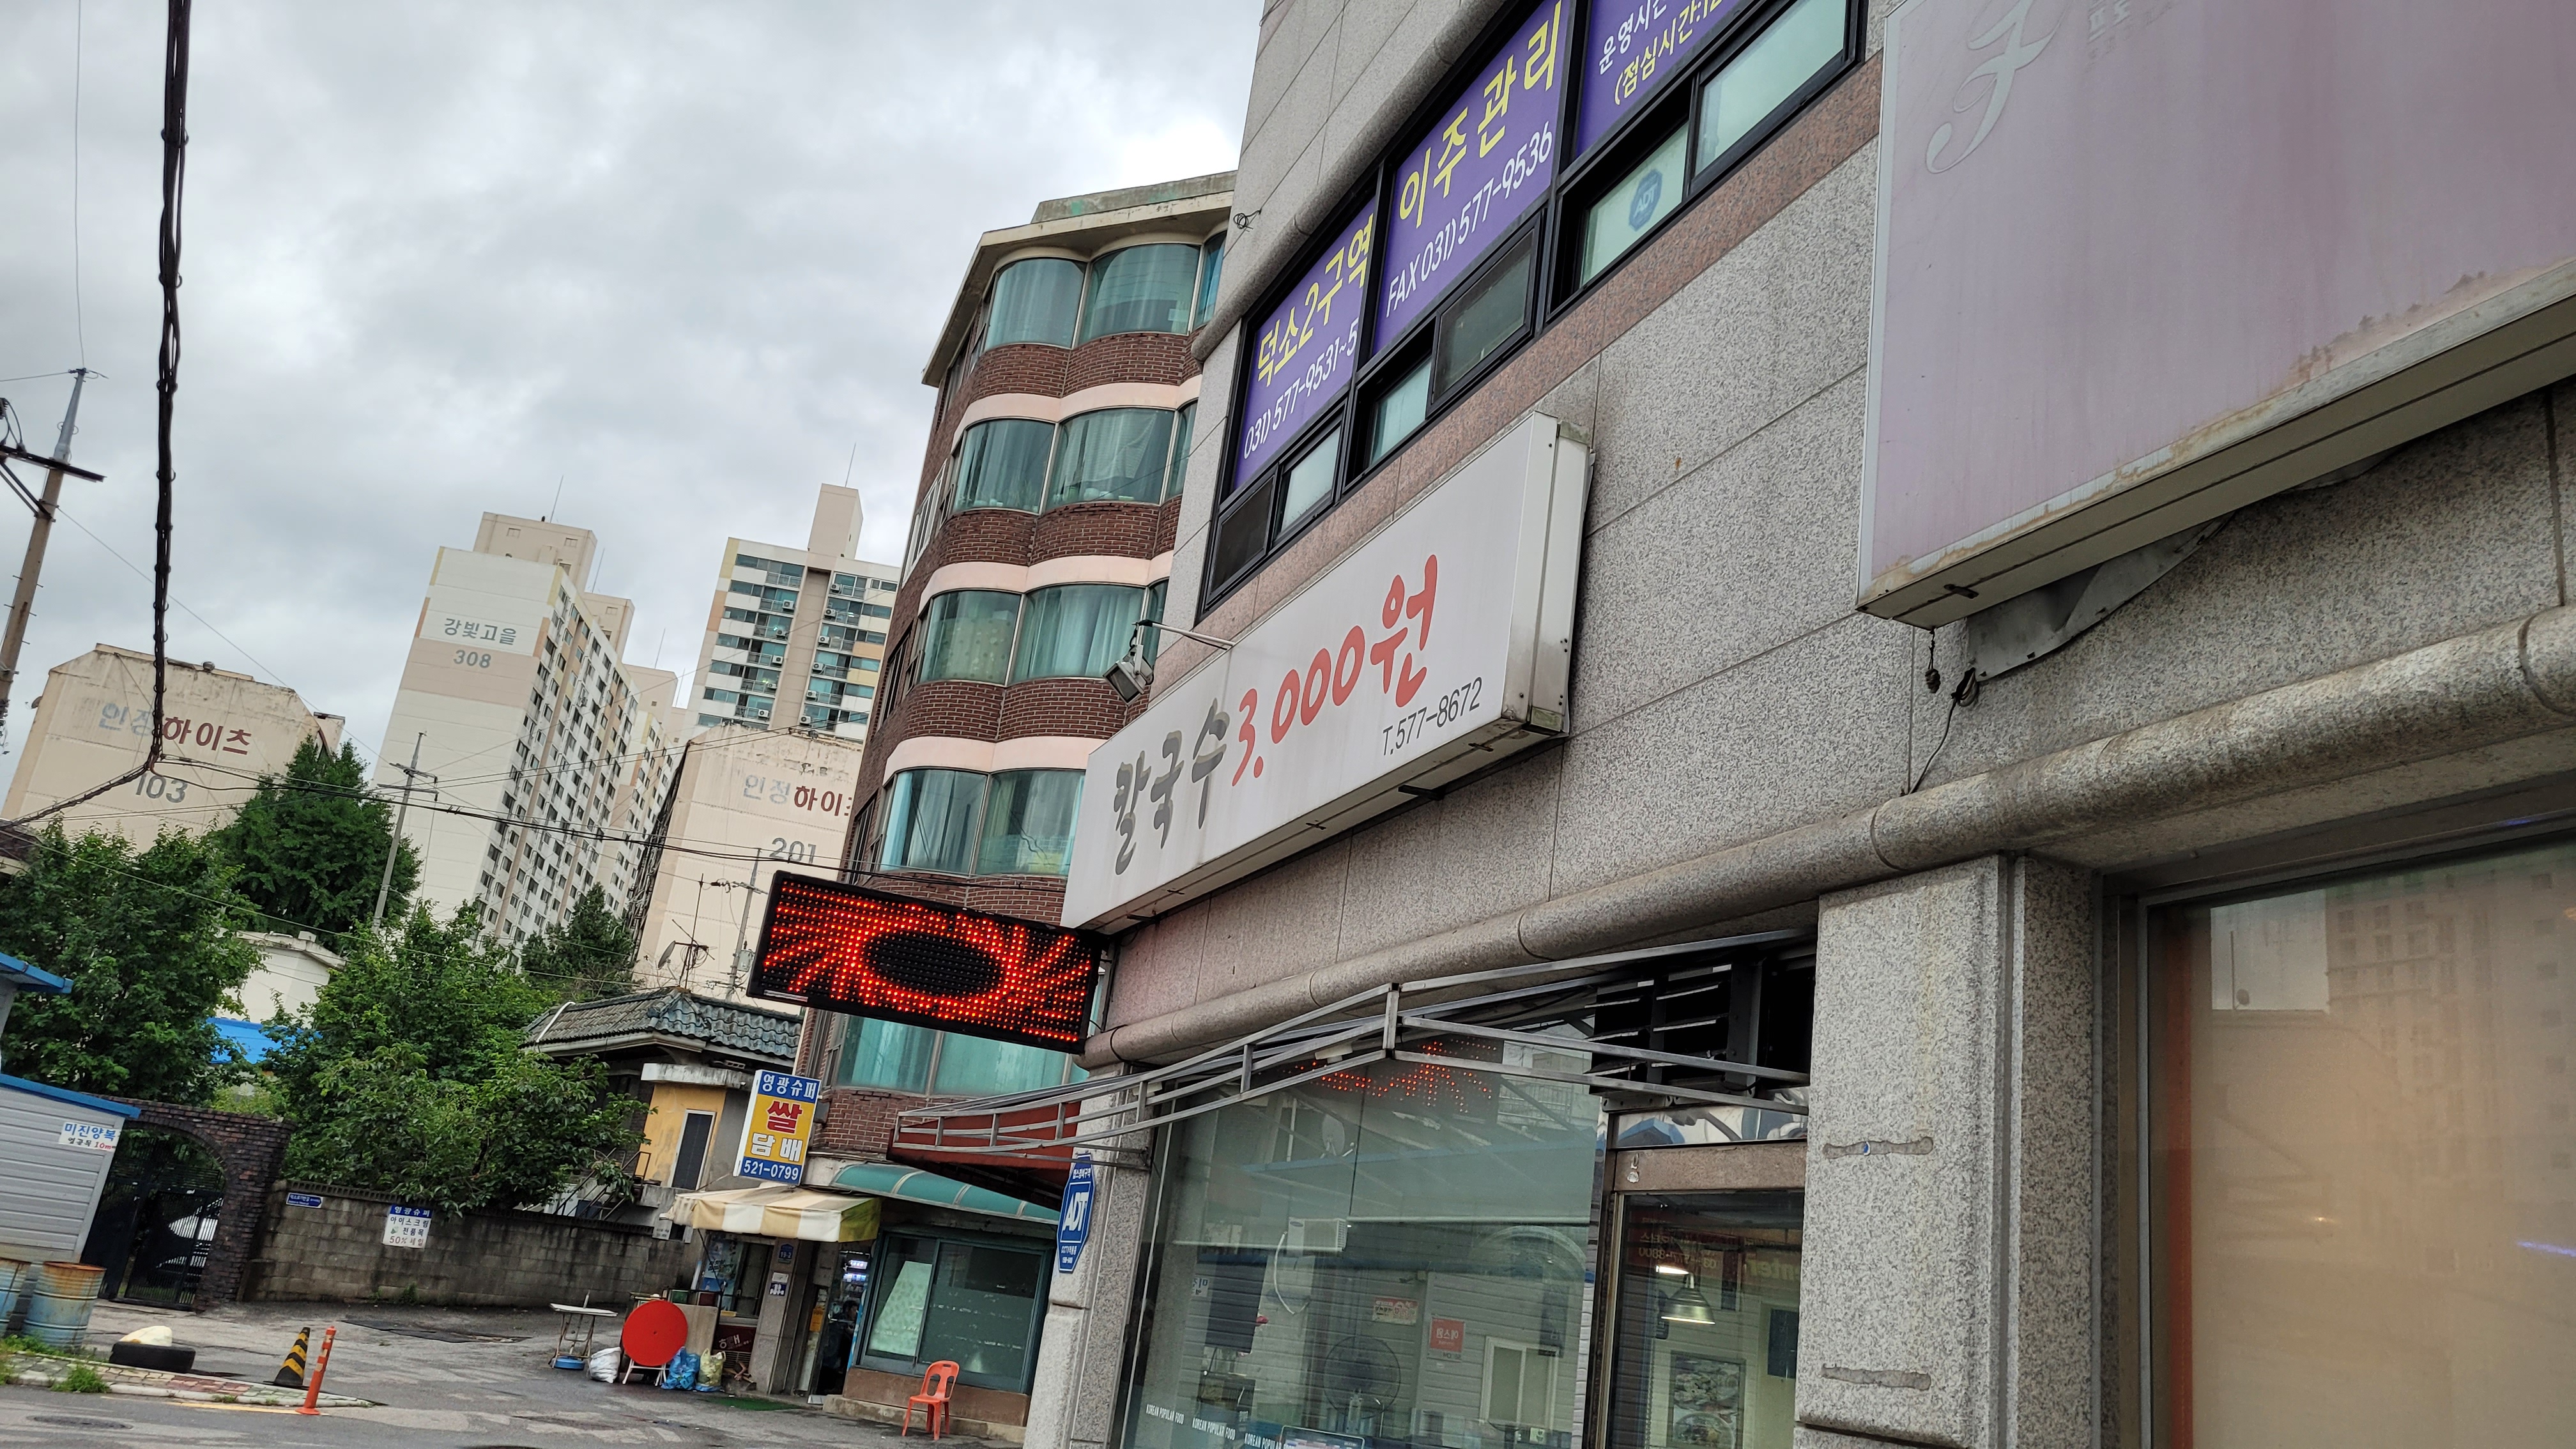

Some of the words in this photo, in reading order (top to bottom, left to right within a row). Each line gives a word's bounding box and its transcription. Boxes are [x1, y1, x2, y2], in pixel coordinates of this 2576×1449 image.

[1399, 0, 1562, 228] 이주관리
[1634, 183, 1658, 218] ADT
[1386, 252, 1422, 318] FAX
[1257, 213, 1373, 387] 덕소2구역
[445, 618, 516, 645] 강빛고을
[453, 649, 491, 668] 308
[1383, 677, 1482, 756] T.577-8672
[135, 772, 188, 803] 103
[1114, 698, 1230, 875] 칼국수
[769, 837, 816, 864] 201
[762, 1074, 817, 1100] 영광슈퍼
[767, 1100, 803, 1134] 쌀
[65, 1123, 116, 1142] 미진양복
[751, 1133, 803, 1162] 담배
[744, 1160, 799, 1181] 521-0799
[390, 1216, 429, 1228] 아이스크림
[394, 1206, 430, 1217] 영광슈퍼
[1062, 1192, 1089, 1232] ADT
[389, 1236, 408, 1244] 50%
[410, 1238, 424, 1246] 세일
[402, 1227, 424, 1236] 전품목
[1146, 1404, 1159, 1416] KOREAN
[1159, 1407, 1175, 1422] POPULAR
[1175, 1412, 1184, 1425] FOOD
[1192, 1417, 1207, 1431] KOREAN
[1207, 1422, 1225, 1437] POPULAR
[1225, 1427, 1236, 1441] FOOD
[1245, 1432, 1261, 1448] KOREAN
